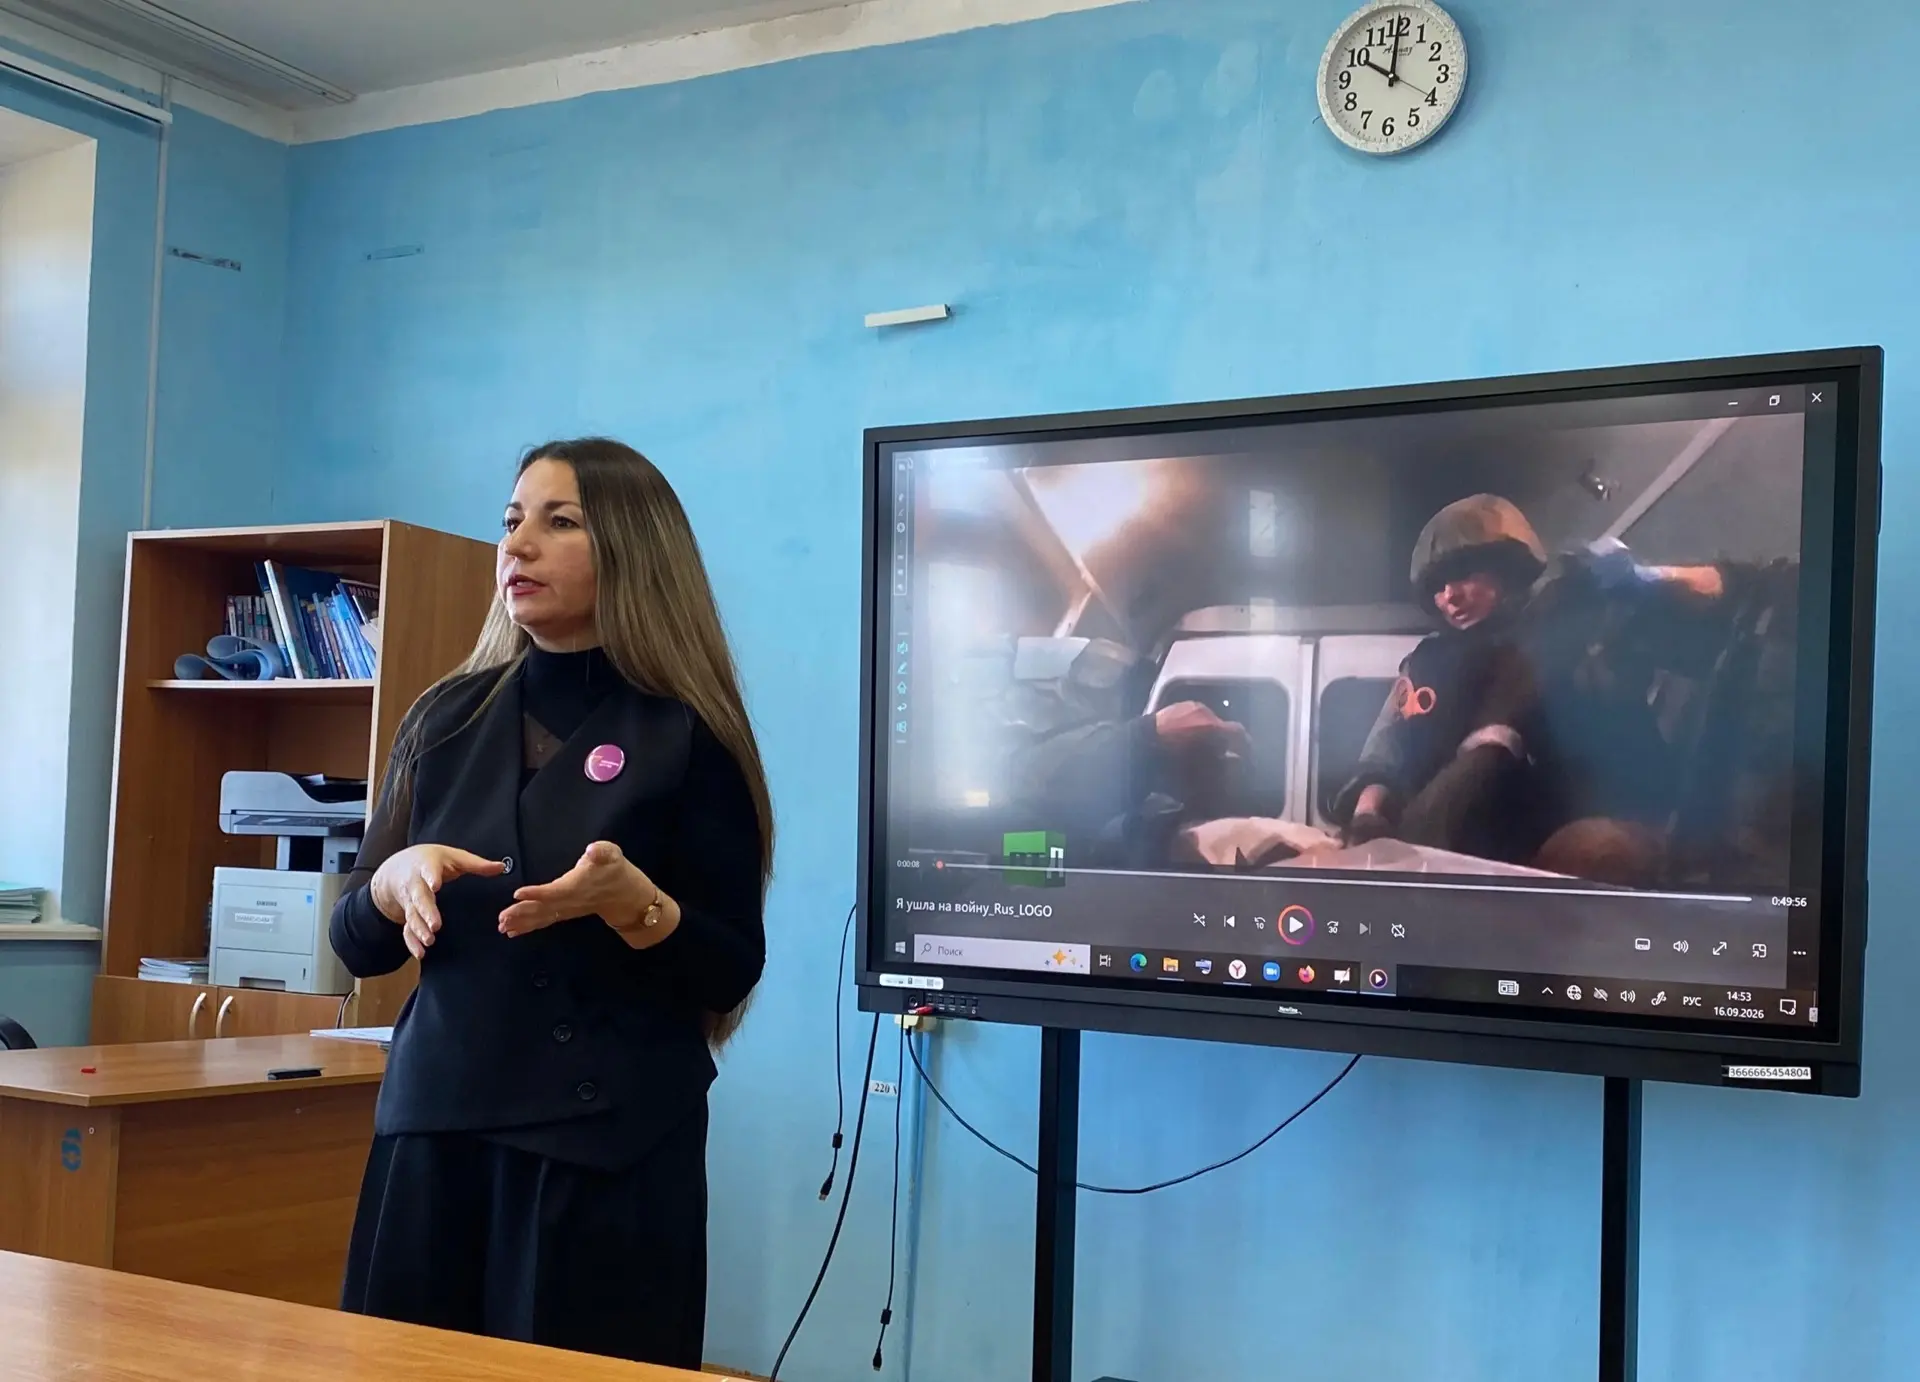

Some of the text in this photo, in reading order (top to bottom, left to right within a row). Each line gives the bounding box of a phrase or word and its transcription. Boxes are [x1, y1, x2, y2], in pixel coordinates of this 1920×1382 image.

[1365, 27, 1387, 47] 11
[1386, 17, 1411, 38] 12
[1415, 23, 1427, 44] 1
[1347, 47, 1370, 68] 10
[1428, 42, 1442, 62] 2
[1339, 70, 1351, 90] 9
[1436, 64, 1449, 83] 3
[1344, 92, 1357, 111] 8
[1424, 87, 1438, 107] 4
[1360, 110, 1373, 130] 7
[1382, 117, 1394, 136] 6
[1407, 107, 1421, 127] 5
[896, 898, 1053, 918] Я ушла на войну_Rus_LOGO
[1771, 896, 1807, 907] 0:49:56
[937, 946, 963, 956] Поиск
[1683, 996, 1702, 1007] РУС
[1726, 991, 1752, 1002] 14:53
[1713, 1006, 1765, 1019] 16.09.2026
[874, 1083, 890, 1093] 220
